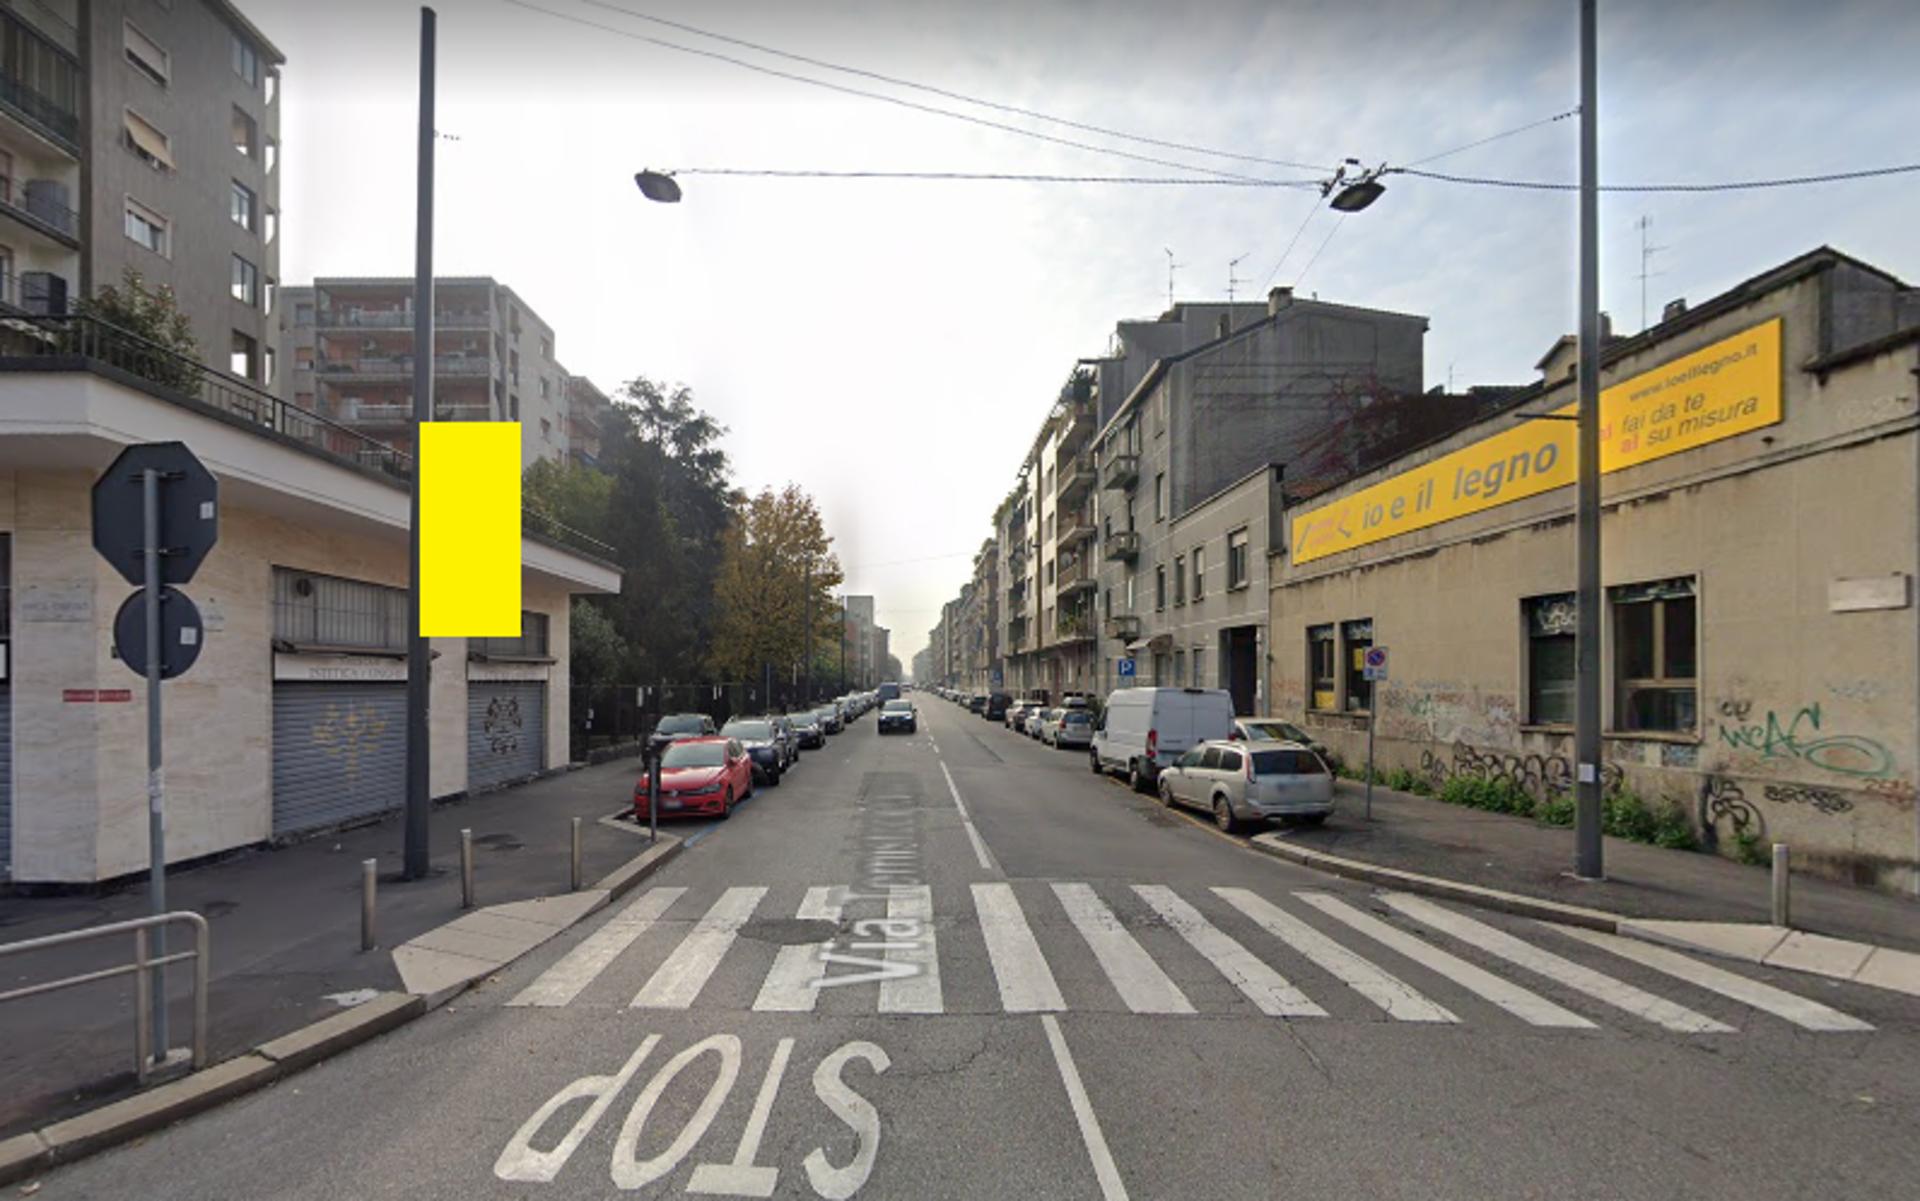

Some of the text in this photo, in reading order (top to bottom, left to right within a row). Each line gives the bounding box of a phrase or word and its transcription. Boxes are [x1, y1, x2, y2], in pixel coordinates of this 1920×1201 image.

[1622, 413, 1645, 434] fai
[1651, 401, 1676, 425] da
[1683, 392, 1705, 413] te
[1647, 428, 1671, 447] su
[1678, 395, 1759, 437] misura
[1390, 495, 1406, 520] e
[1415, 478, 1434, 514] il
[1453, 442, 1559, 500] legno
[493, 1033, 891, 1200] STOP
